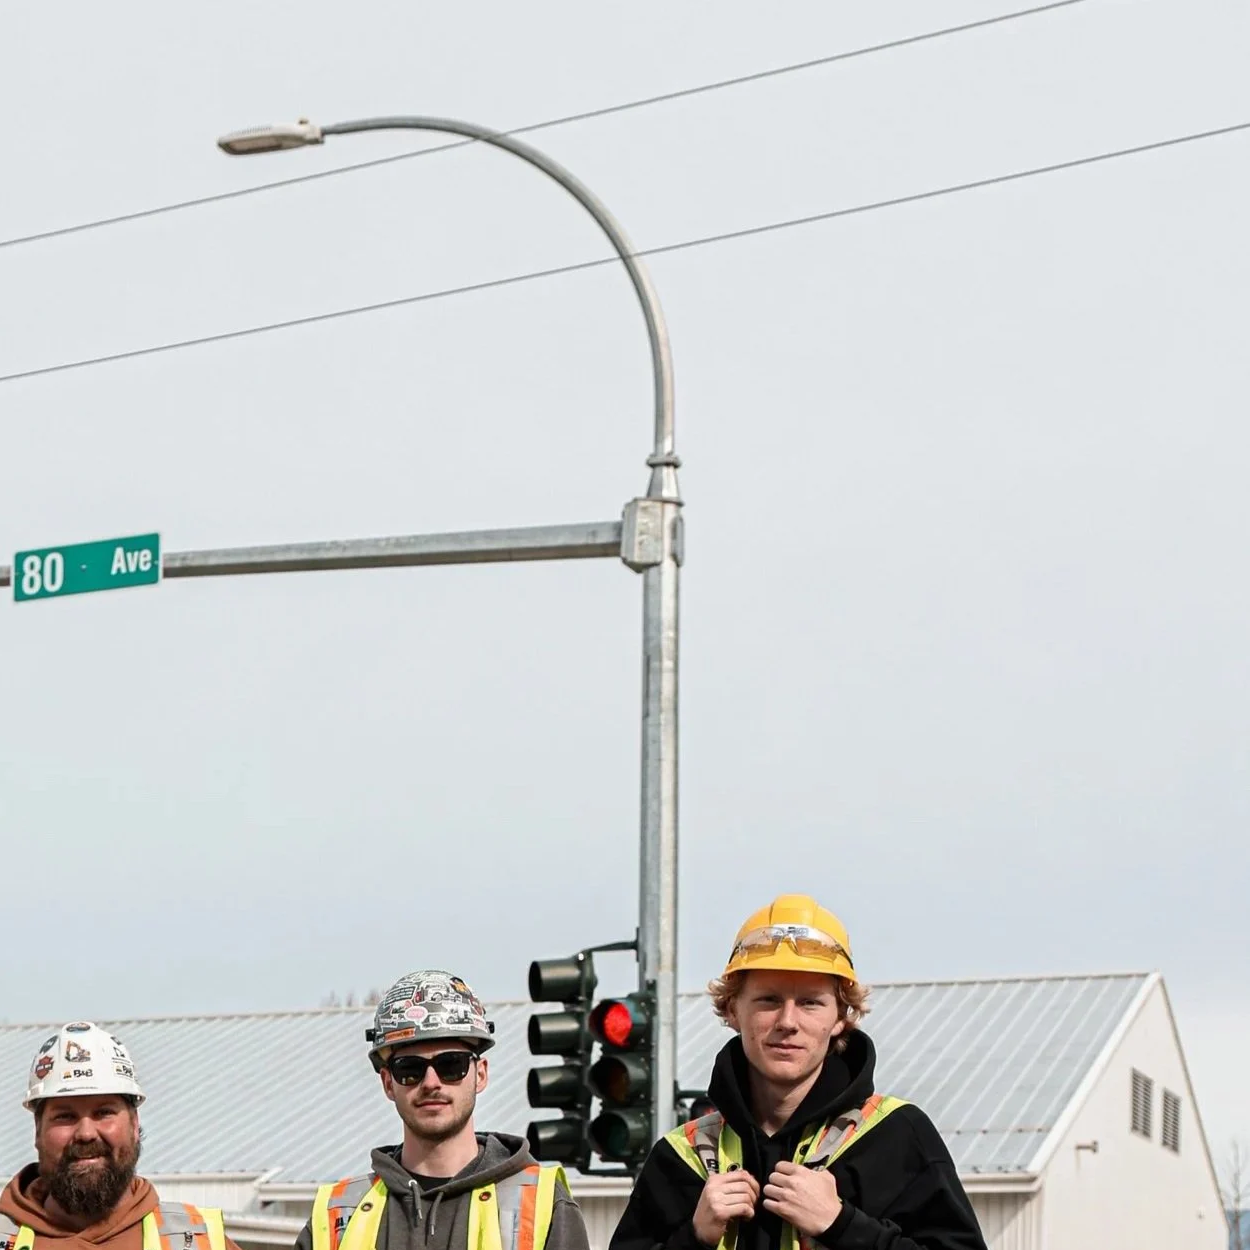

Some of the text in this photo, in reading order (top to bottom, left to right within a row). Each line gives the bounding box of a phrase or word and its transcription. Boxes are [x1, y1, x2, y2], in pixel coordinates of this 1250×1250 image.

[21, 547, 152, 595] 80 Ave
[73, 1069, 93, 1077] B&B
